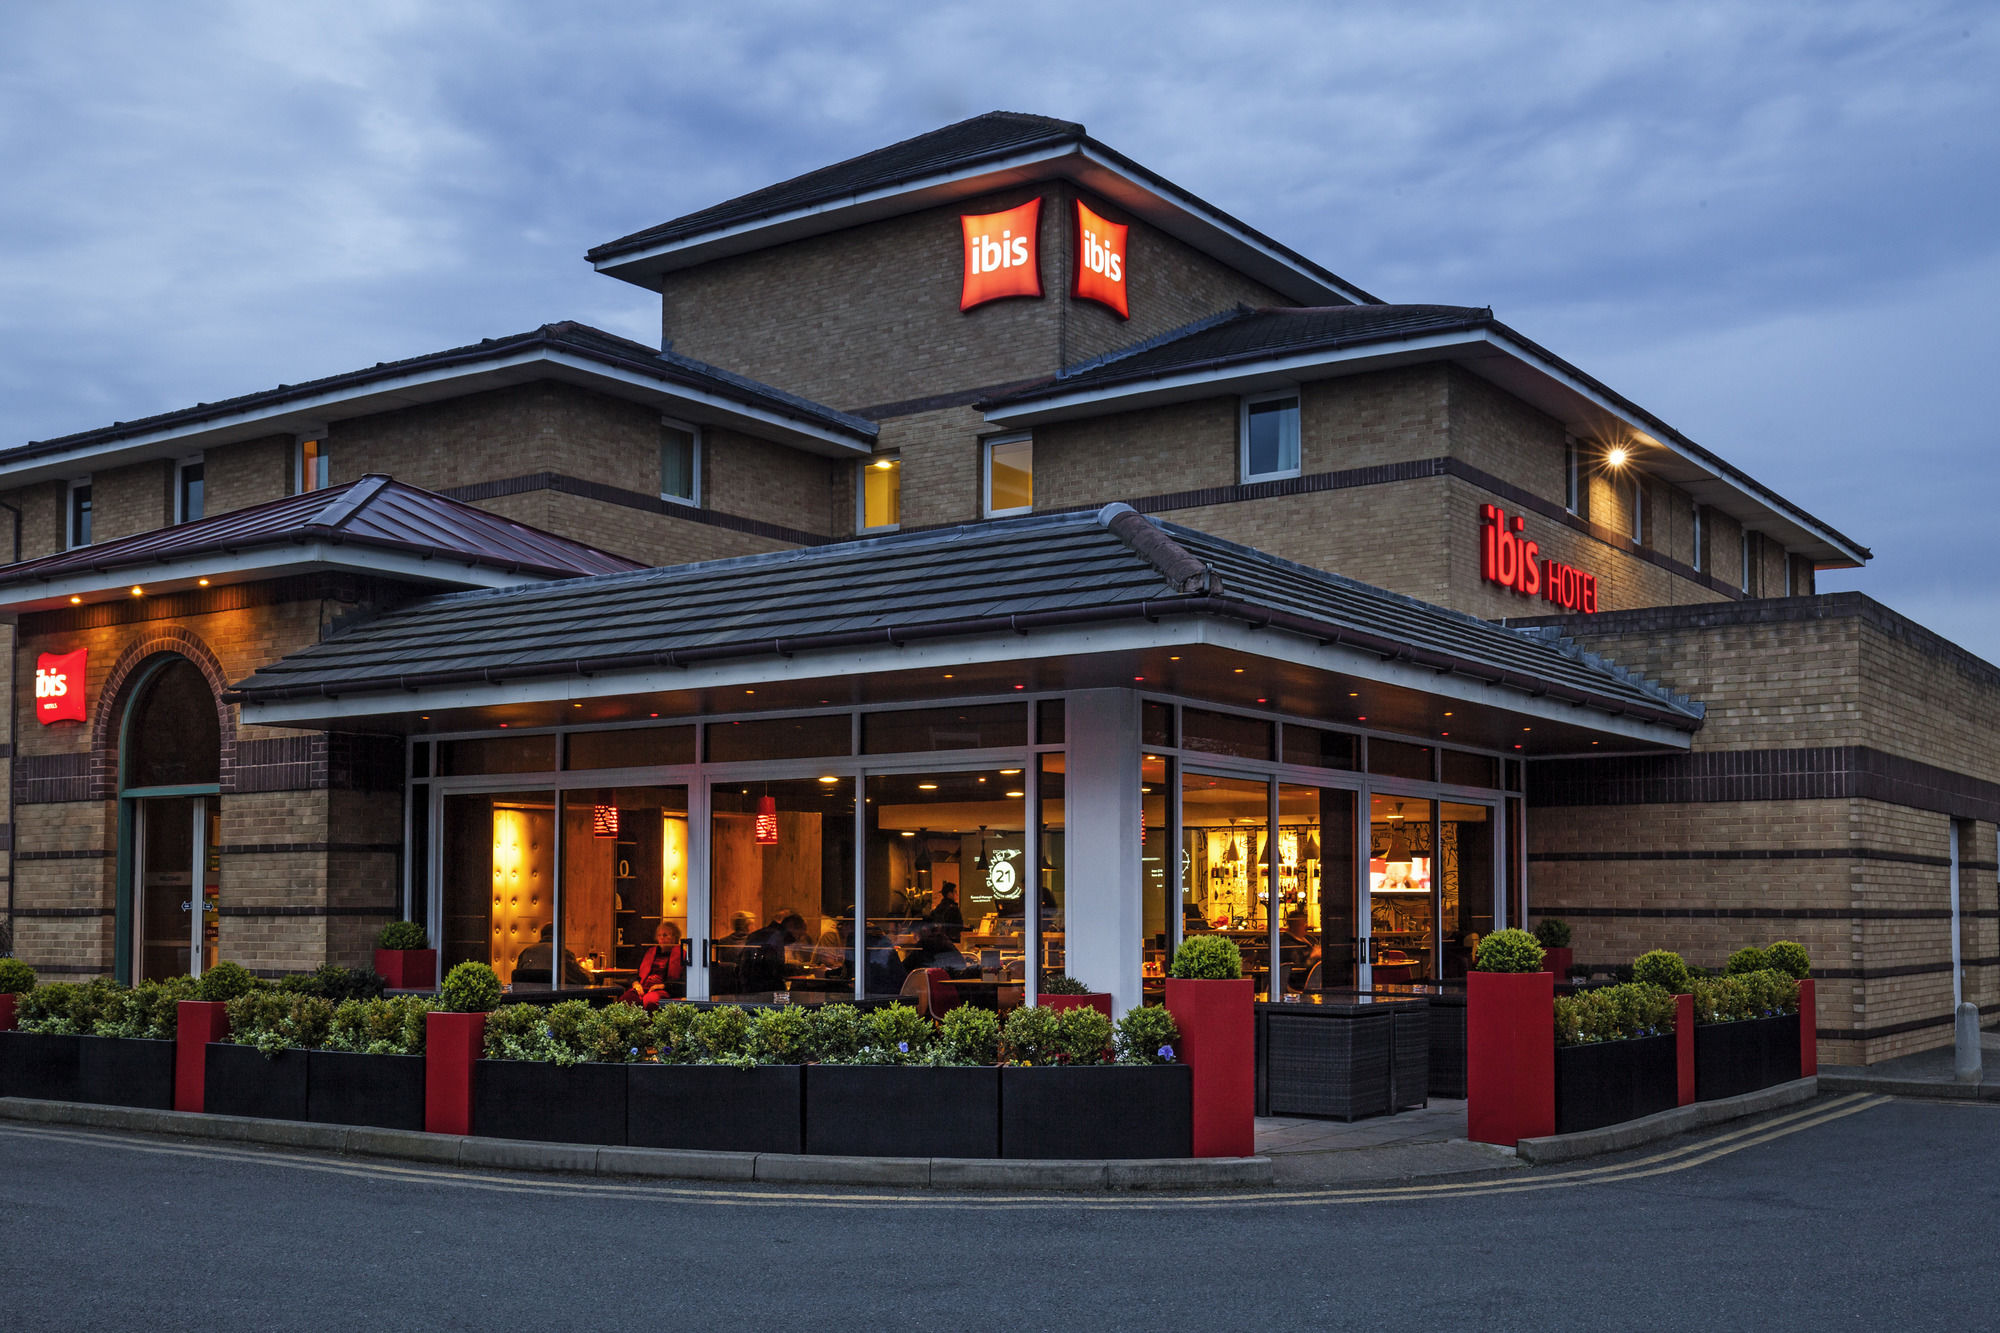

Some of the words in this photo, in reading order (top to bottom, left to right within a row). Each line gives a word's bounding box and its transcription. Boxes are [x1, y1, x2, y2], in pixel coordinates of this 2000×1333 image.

[972, 230, 1028, 275] ibis
[1084, 229, 1122, 282] ibis
[1480, 504, 1540, 595] ibis
[1545, 559, 1598, 614] HOTEL
[36, 667, 67, 698] ibis
[995, 869, 1011, 883] 21
